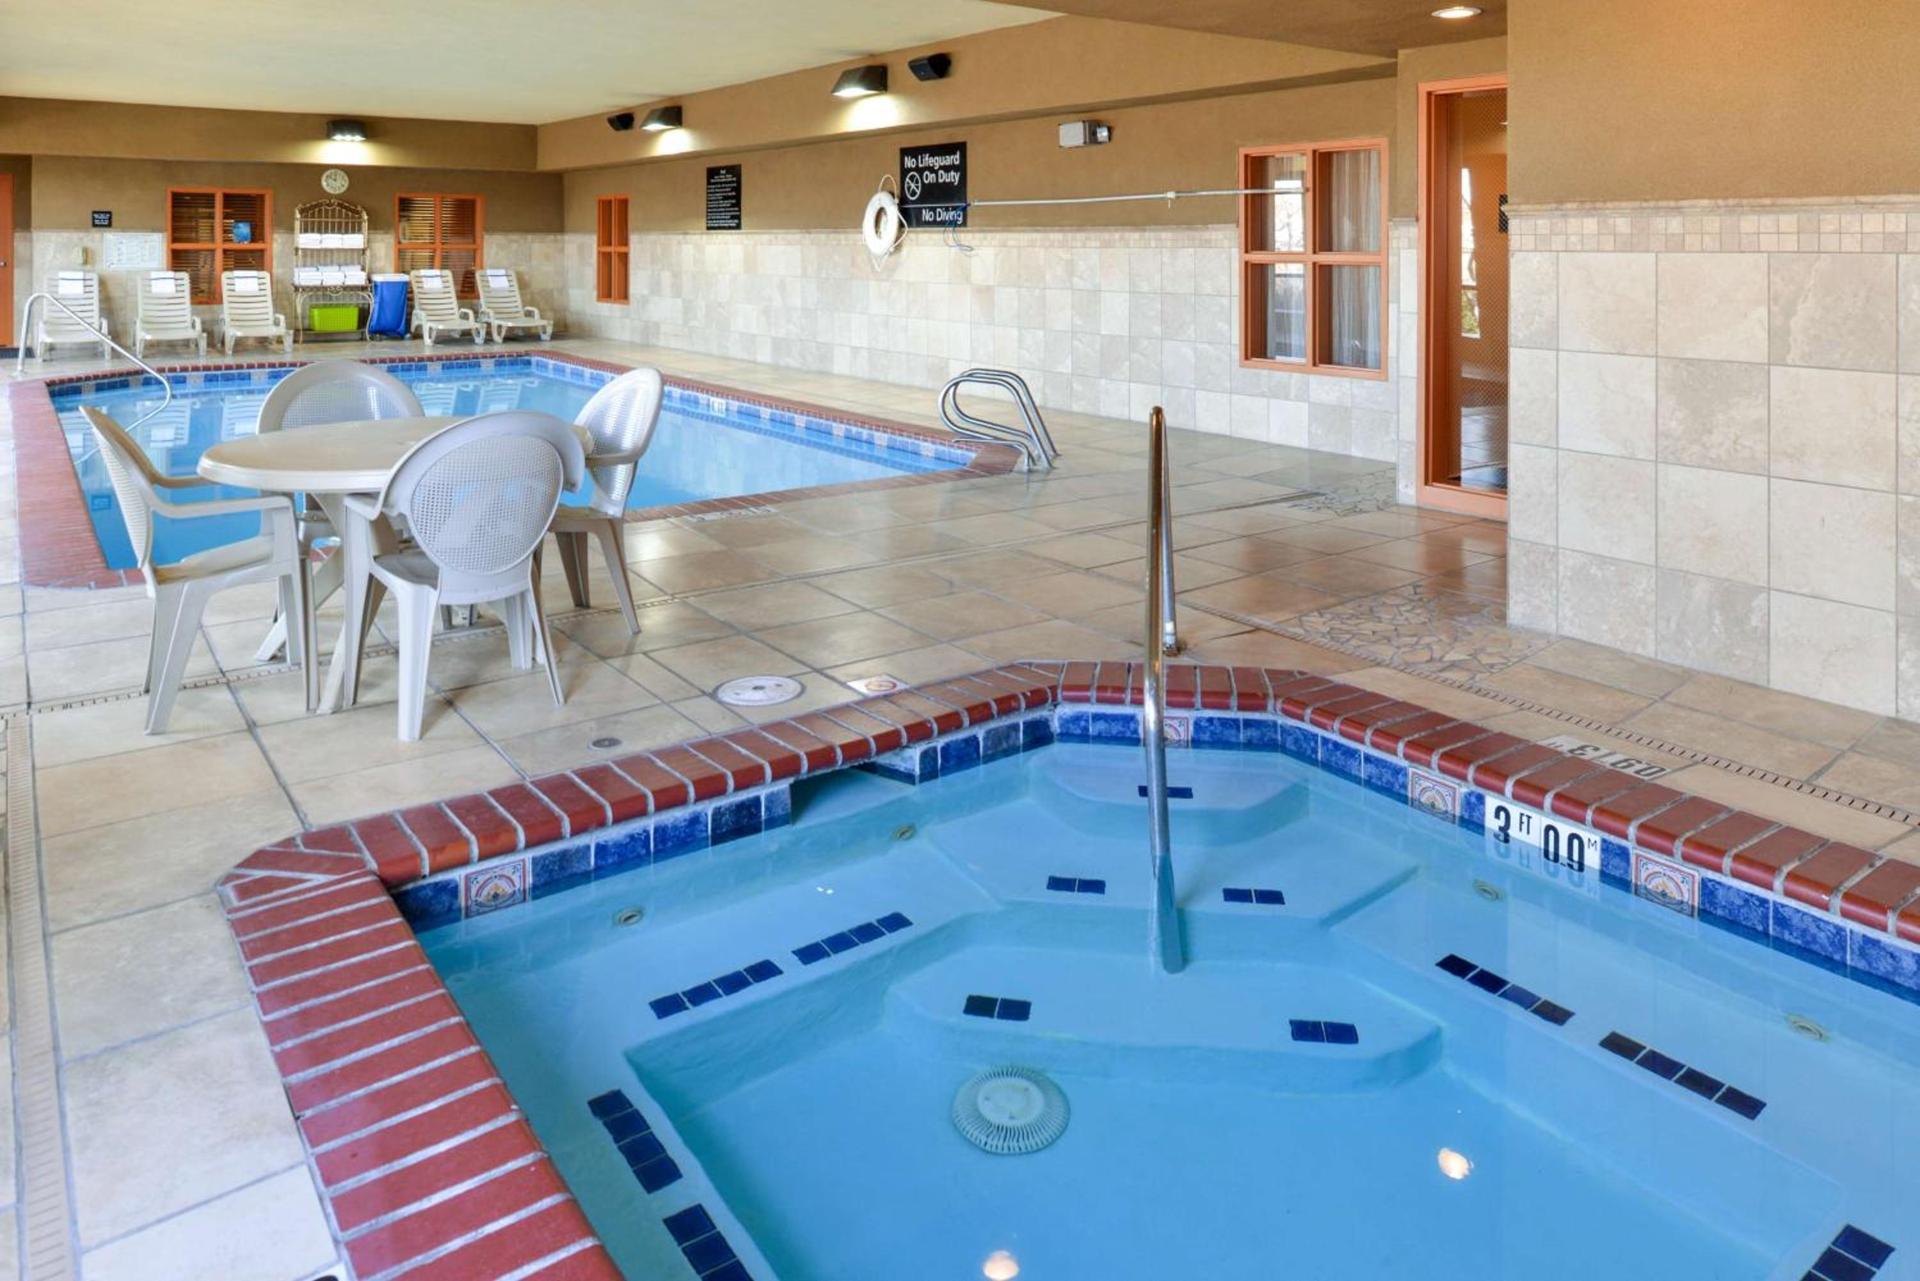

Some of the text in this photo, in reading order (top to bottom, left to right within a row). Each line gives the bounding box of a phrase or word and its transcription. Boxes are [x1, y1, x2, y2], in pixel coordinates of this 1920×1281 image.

[904, 149, 960, 170] No Lifeguard
[923, 169, 960, 186] On Duty
[922, 207, 963, 225] No Diving
[1493, 805, 1511, 844] 3
[1519, 812, 1533, 835] FT
[1587, 837, 1598, 851] M
